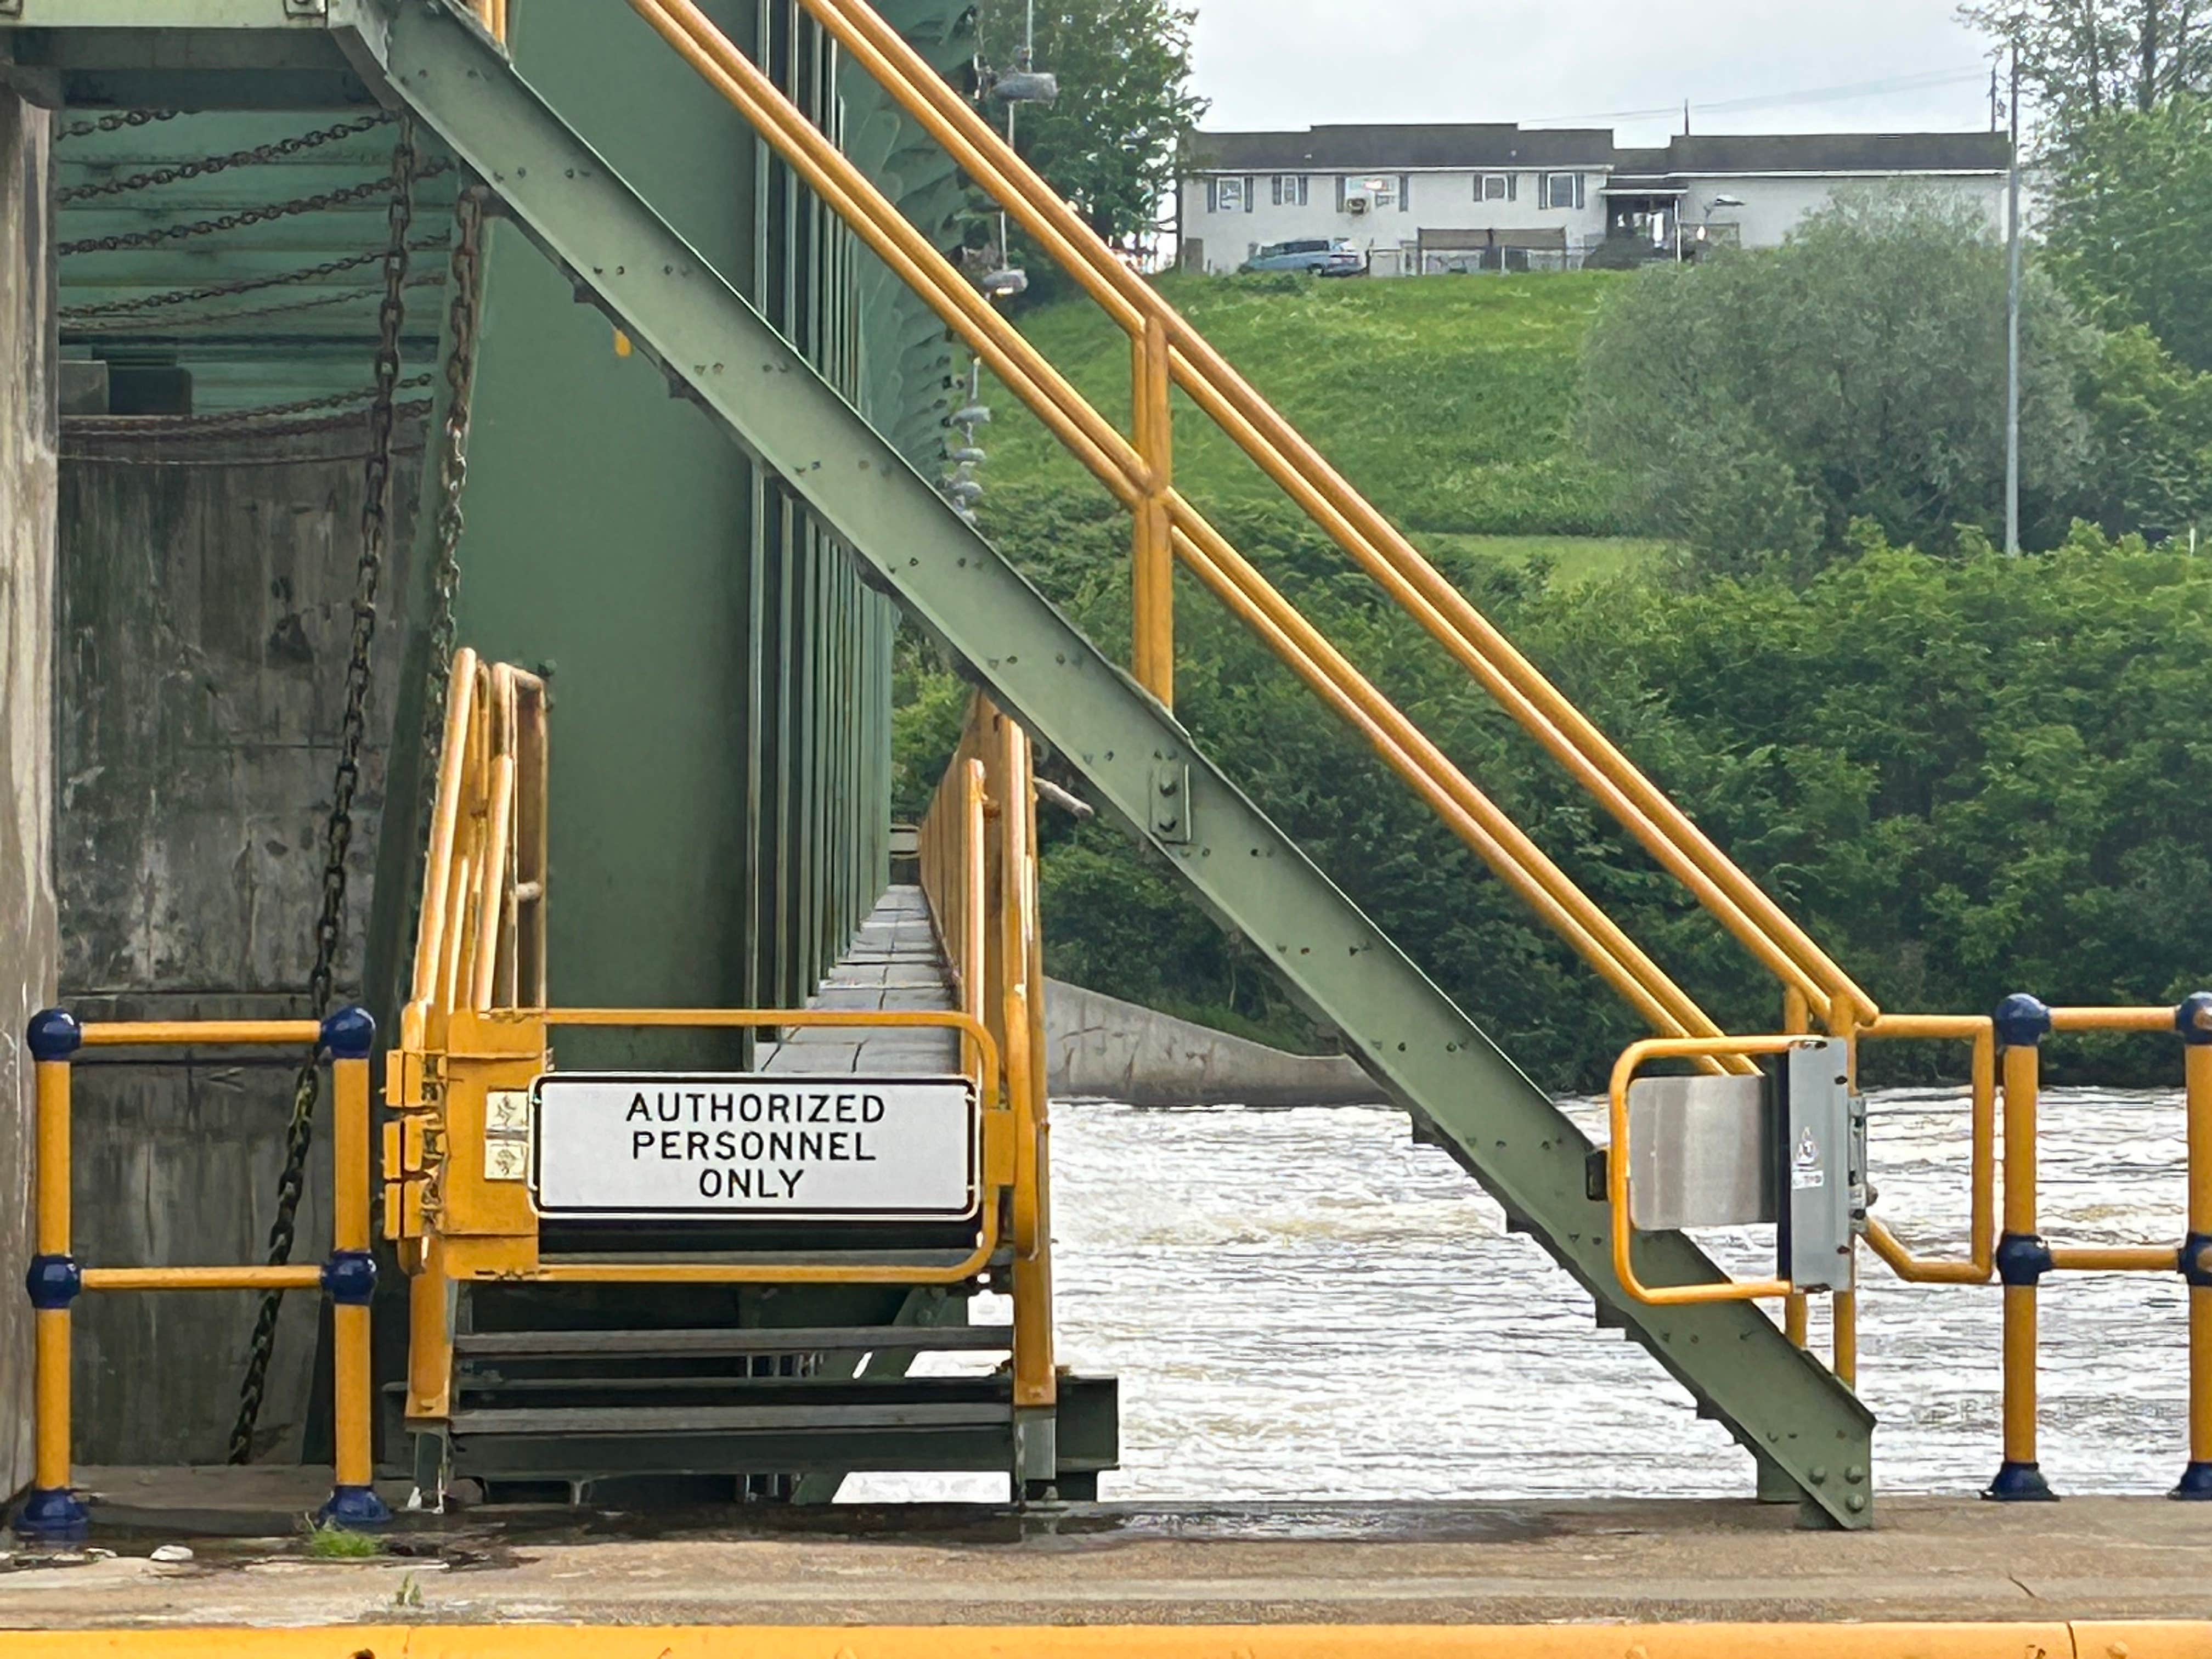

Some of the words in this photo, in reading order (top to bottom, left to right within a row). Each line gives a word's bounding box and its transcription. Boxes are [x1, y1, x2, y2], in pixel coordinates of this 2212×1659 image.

[626, 1092, 884, 1123] AUTHORIZED
[633, 1131, 876, 1161] PERSONNEL
[699, 1169, 804, 1198] ONLY
